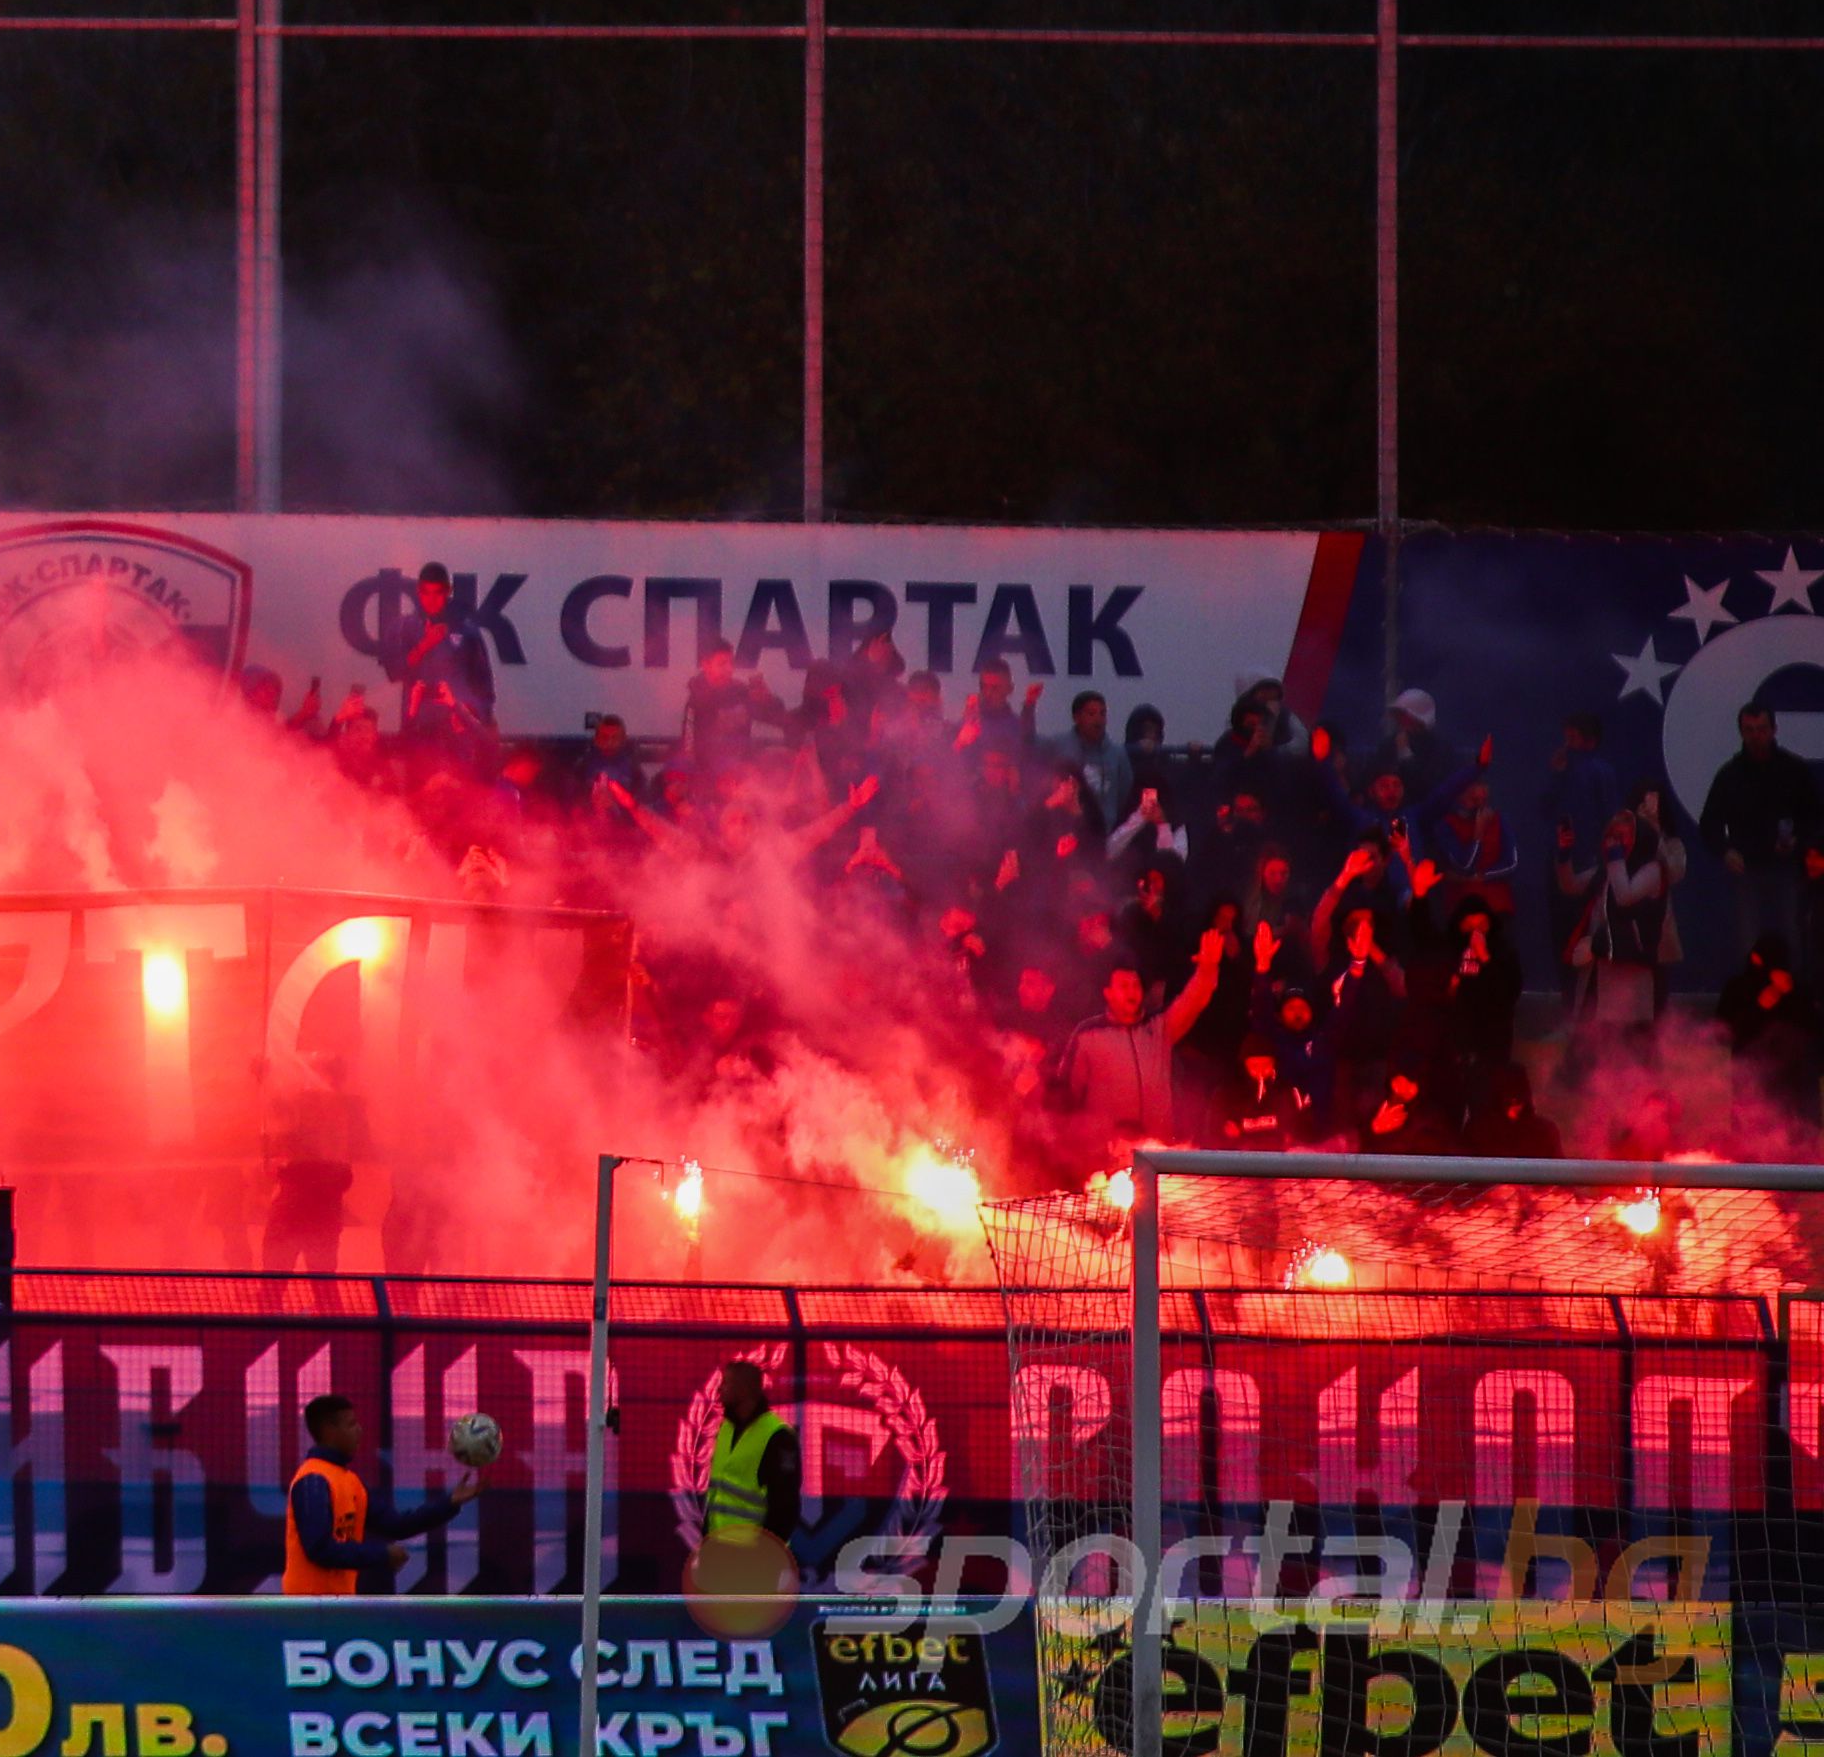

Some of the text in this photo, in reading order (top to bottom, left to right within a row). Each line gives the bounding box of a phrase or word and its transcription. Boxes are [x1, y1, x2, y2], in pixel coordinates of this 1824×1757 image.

[339, 567, 1145, 680] ФК СПАРТАК
[283, 1639, 784, 1696] БОНУС СЛЕД
[828, 1631, 971, 1665] efbet
[858, 1671, 947, 1692] ЛИГА
[1094, 1623, 1700, 1757] efbet
[289, 1711, 789, 1757] ВСЕКИ КРЪГ
